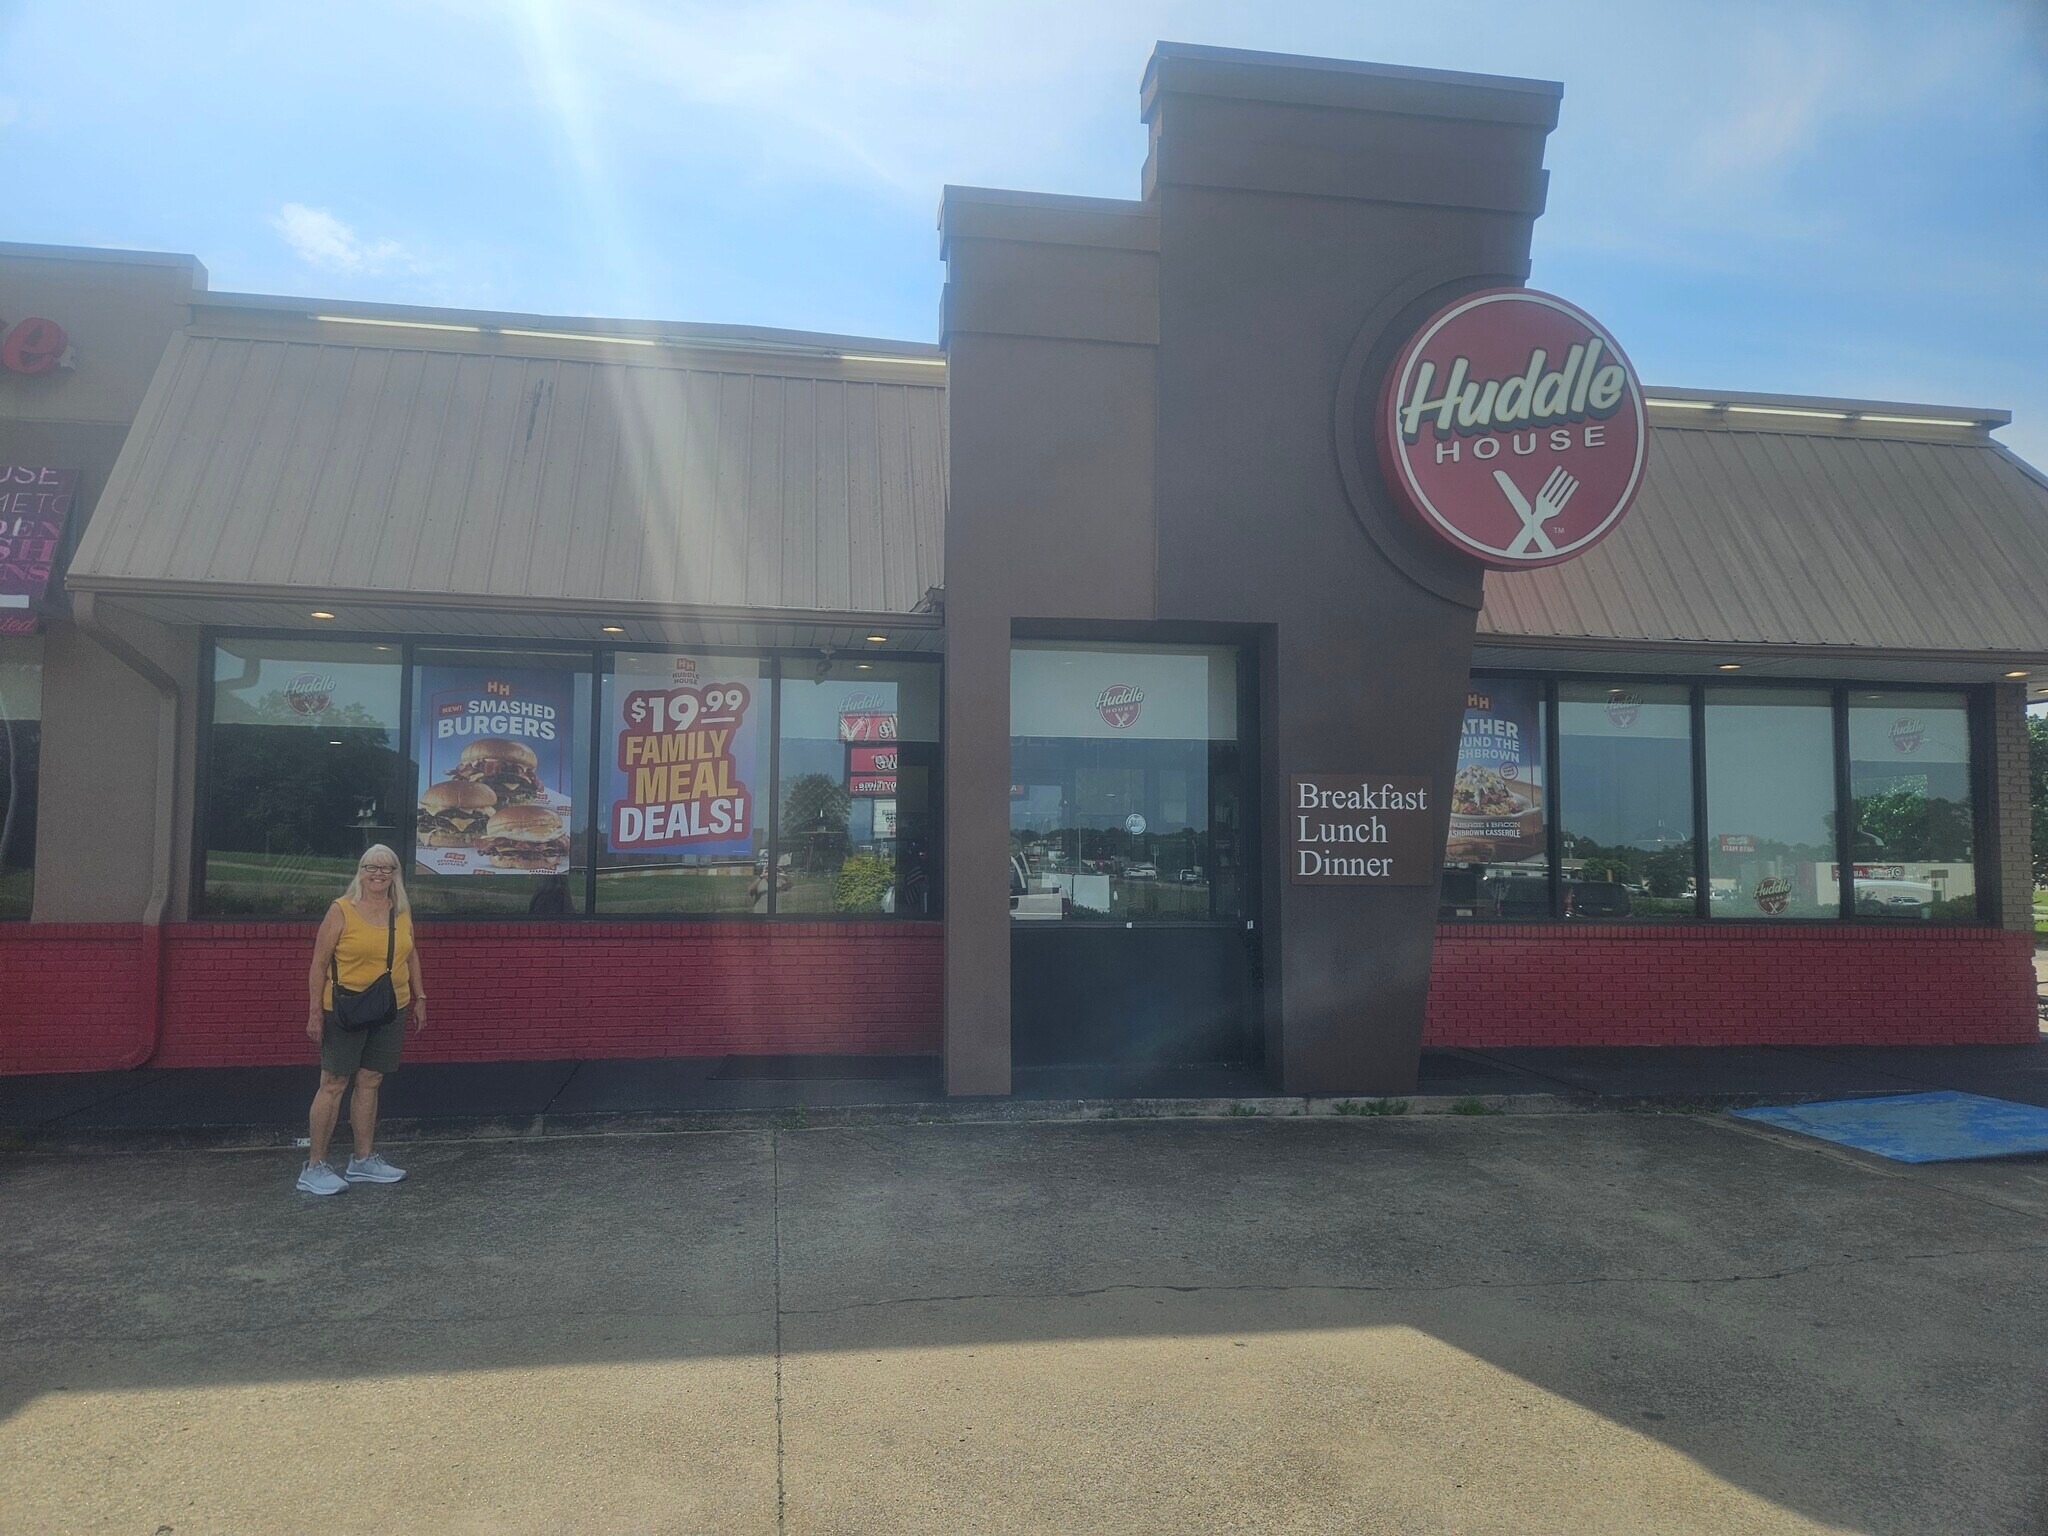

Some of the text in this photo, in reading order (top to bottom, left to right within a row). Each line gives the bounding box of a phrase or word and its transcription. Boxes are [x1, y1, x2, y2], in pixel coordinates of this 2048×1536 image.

[1400, 337, 1627, 444] Huddle
[1436, 426, 1606, 464] HOUSE
[1553, 526, 1565, 534] TM
[678, 659, 695, 671] HH
[283, 675, 335, 697] Huddle
[673, 672, 700, 680] HUDDLE
[487, 681, 510, 696] HH
[1095, 686, 1144, 709] Huddle
[442, 699, 556, 720] NEW! SMASHED
[631, 689, 743, 733] $19.99
[839, 693, 884, 714] Huddle
[1105, 705, 1134, 714] HOUSE
[1468, 694, 1489, 709] HH
[438, 715, 556, 740] BURGERS
[1888, 719, 1924, 737] Huddle
[626, 729, 729, 765] FAMILY
[1495, 737, 1519, 752] THE
[1459, 749, 1520, 764] SHBROWN
[635, 760, 739, 804] MEAL
[1297, 782, 1428, 811] Breakfast
[619, 798, 744, 842] DEALS!
[1297, 815, 1389, 843] Lunch
[1491, 821, 1521, 829] BACON
[1485, 829, 1521, 838] CASSEROLE
[1297, 849, 1394, 877] Dinner
[1754, 879, 1791, 898] Huddle
